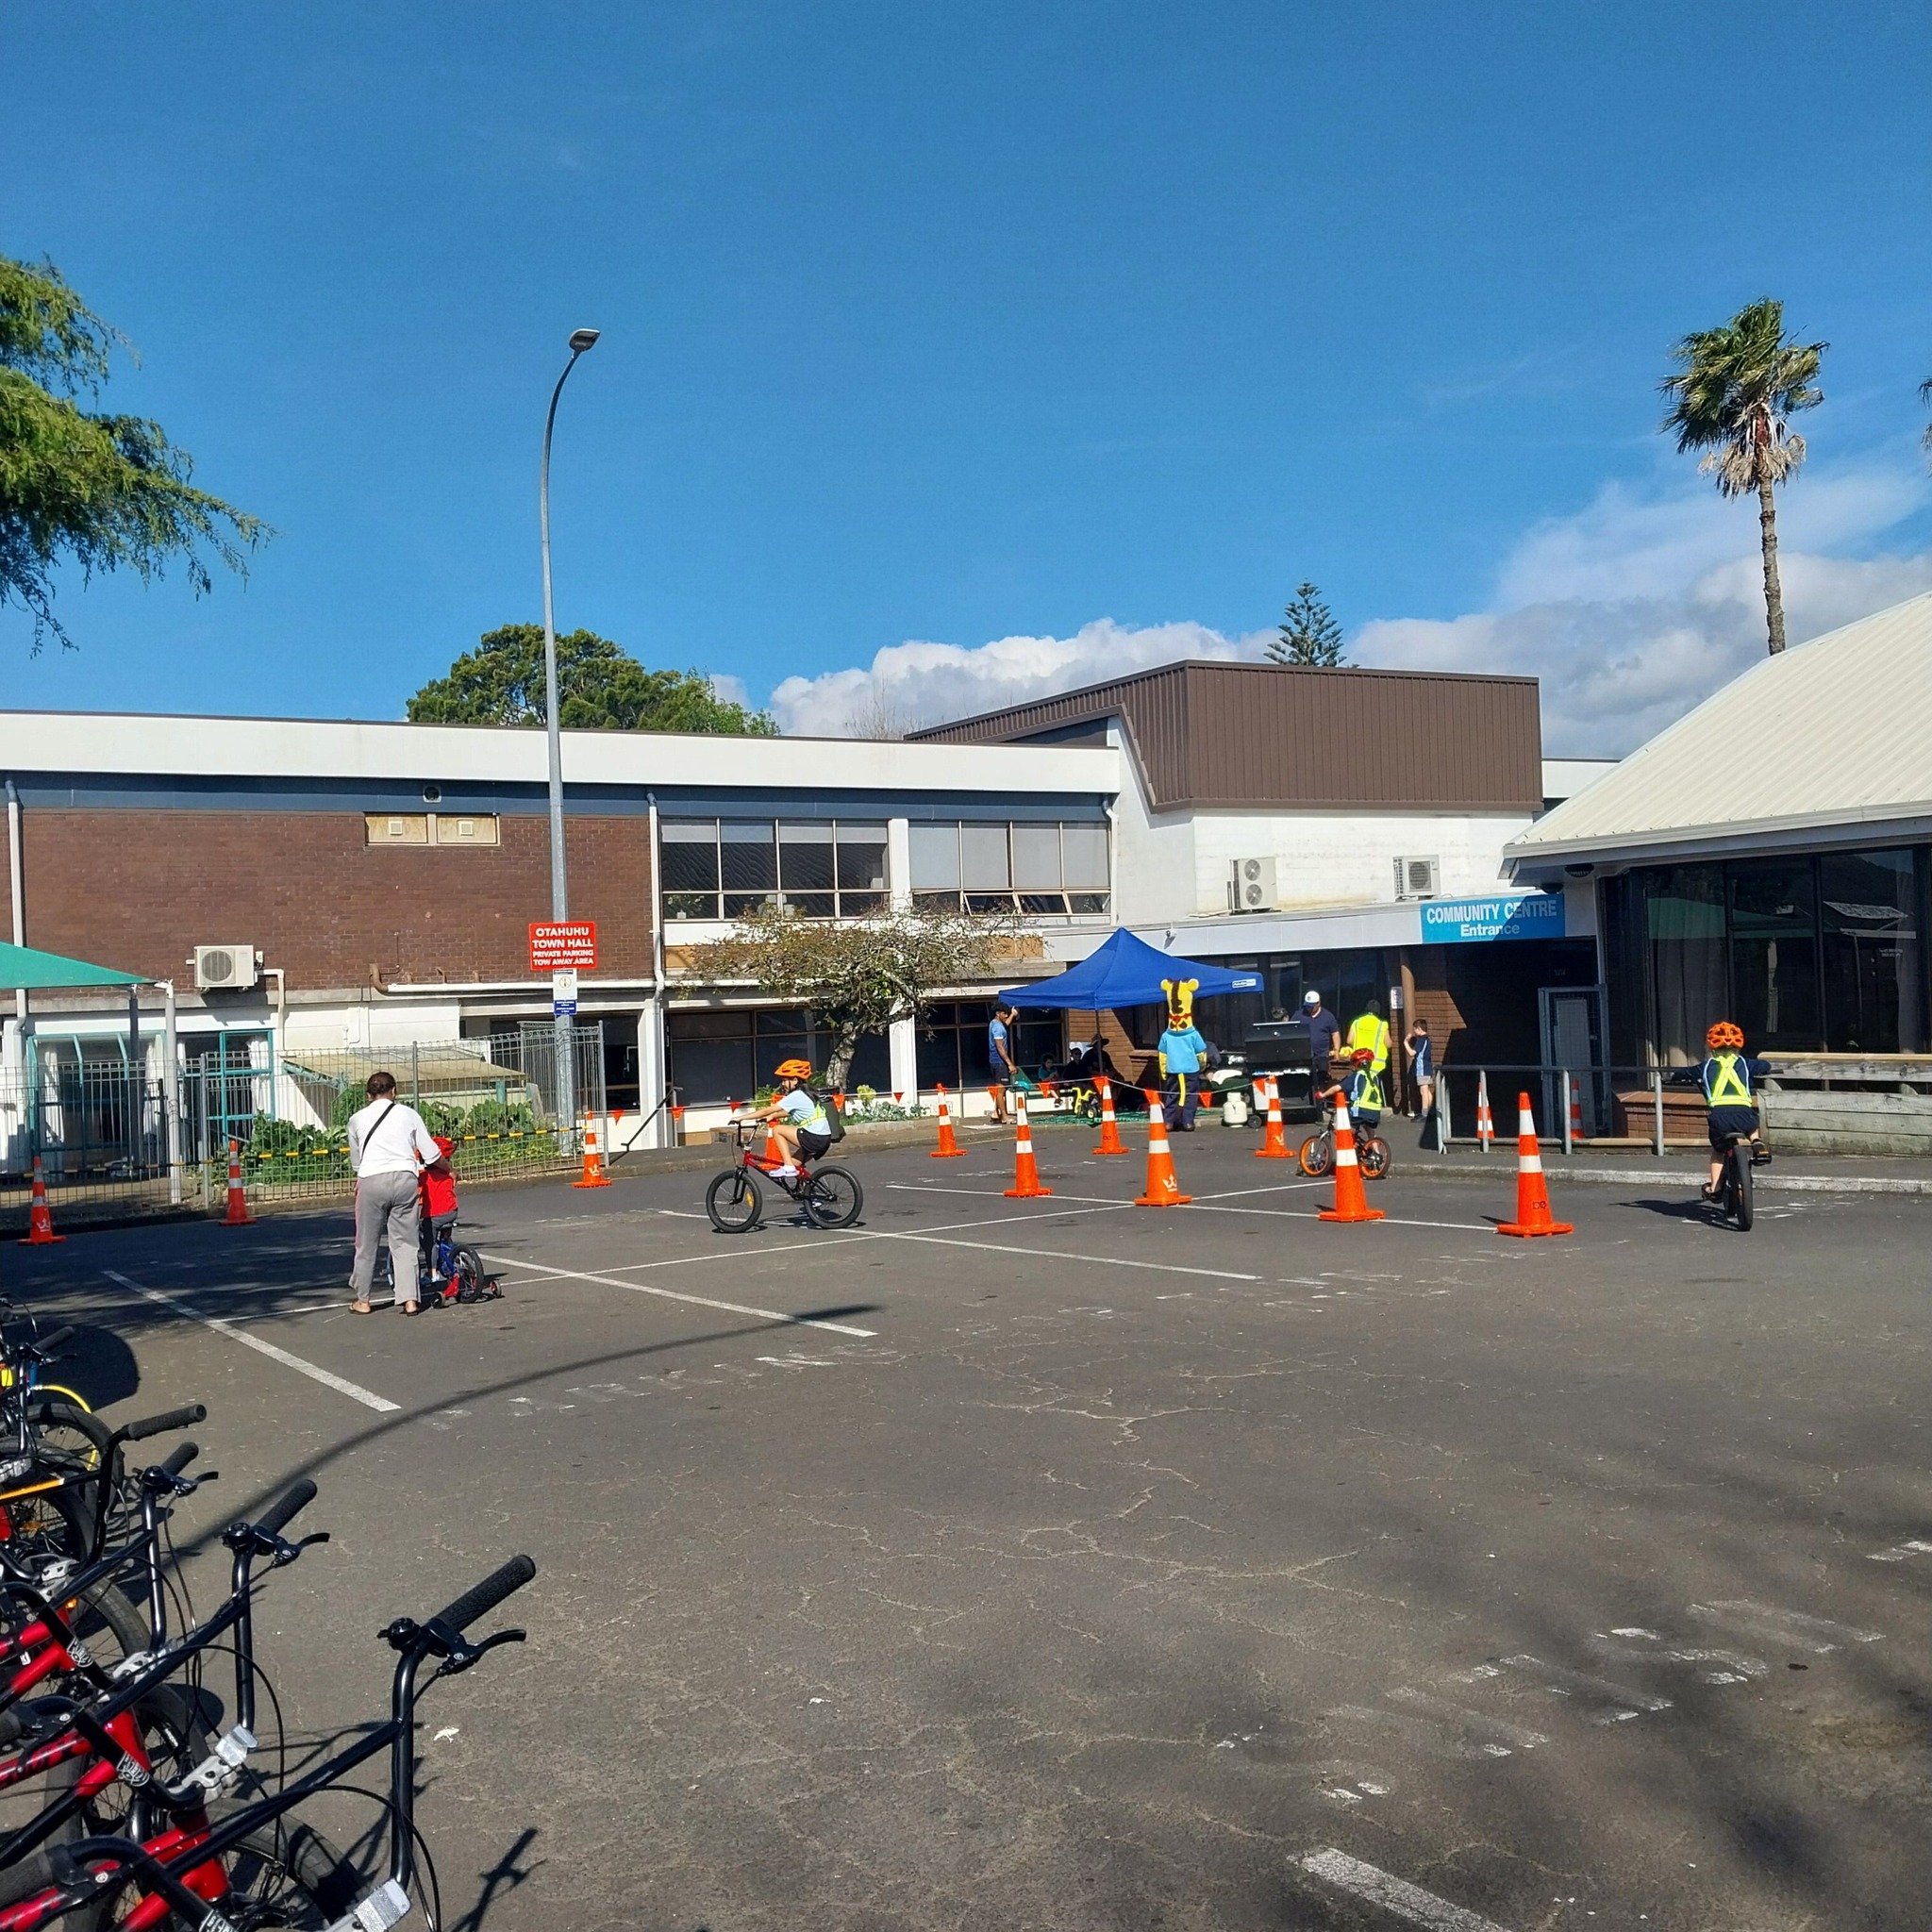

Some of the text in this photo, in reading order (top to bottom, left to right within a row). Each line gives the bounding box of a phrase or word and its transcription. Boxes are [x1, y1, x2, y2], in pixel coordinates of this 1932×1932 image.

[1426, 899, 1557, 924] COMMUNITY CENTRE
[535, 927, 590, 937] OTAHUHU
[1460, 924, 1520, 937] Entrance
[532, 939, 593, 948] TOWN HALL
